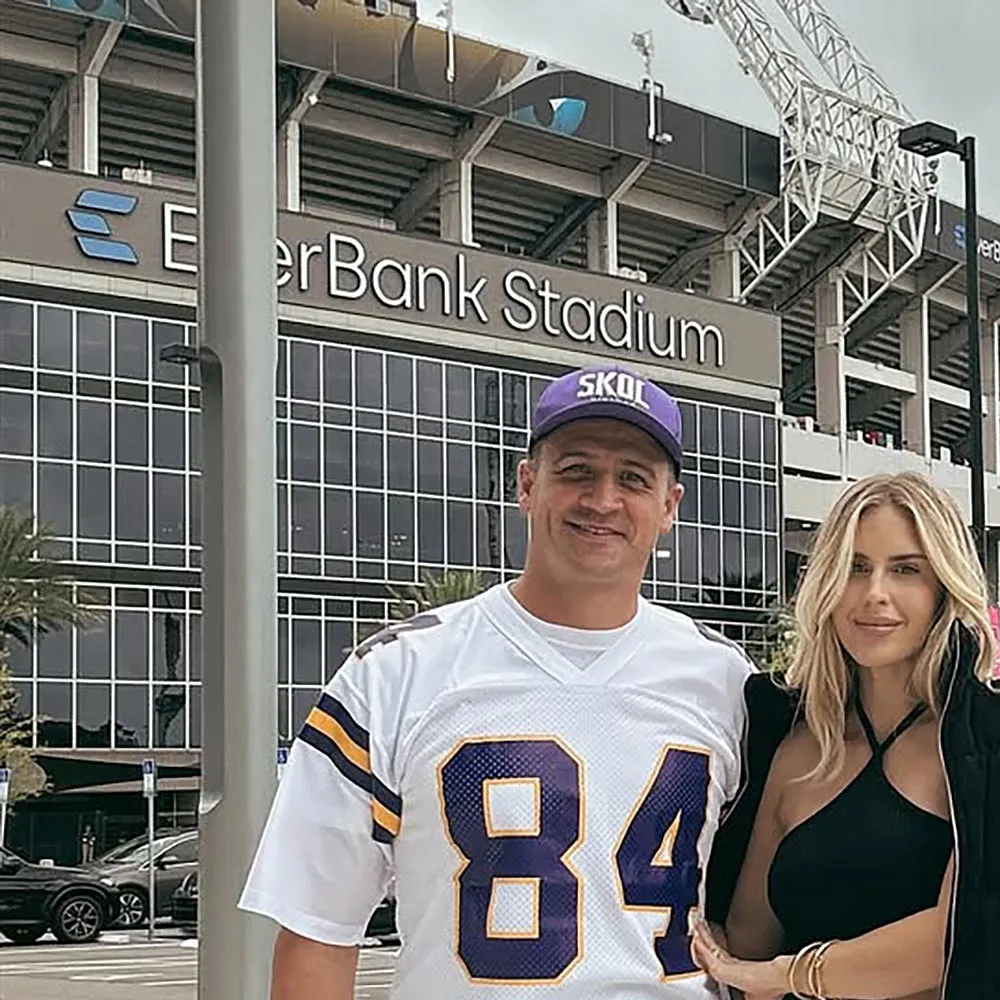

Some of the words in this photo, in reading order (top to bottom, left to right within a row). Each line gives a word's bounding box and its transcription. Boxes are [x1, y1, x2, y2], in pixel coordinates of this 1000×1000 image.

[163, 202, 488, 323] EerBank
[503, 269, 724, 367] Stadium
[577, 371, 650, 410] SKOL
[434, 734, 712, 983] 84
